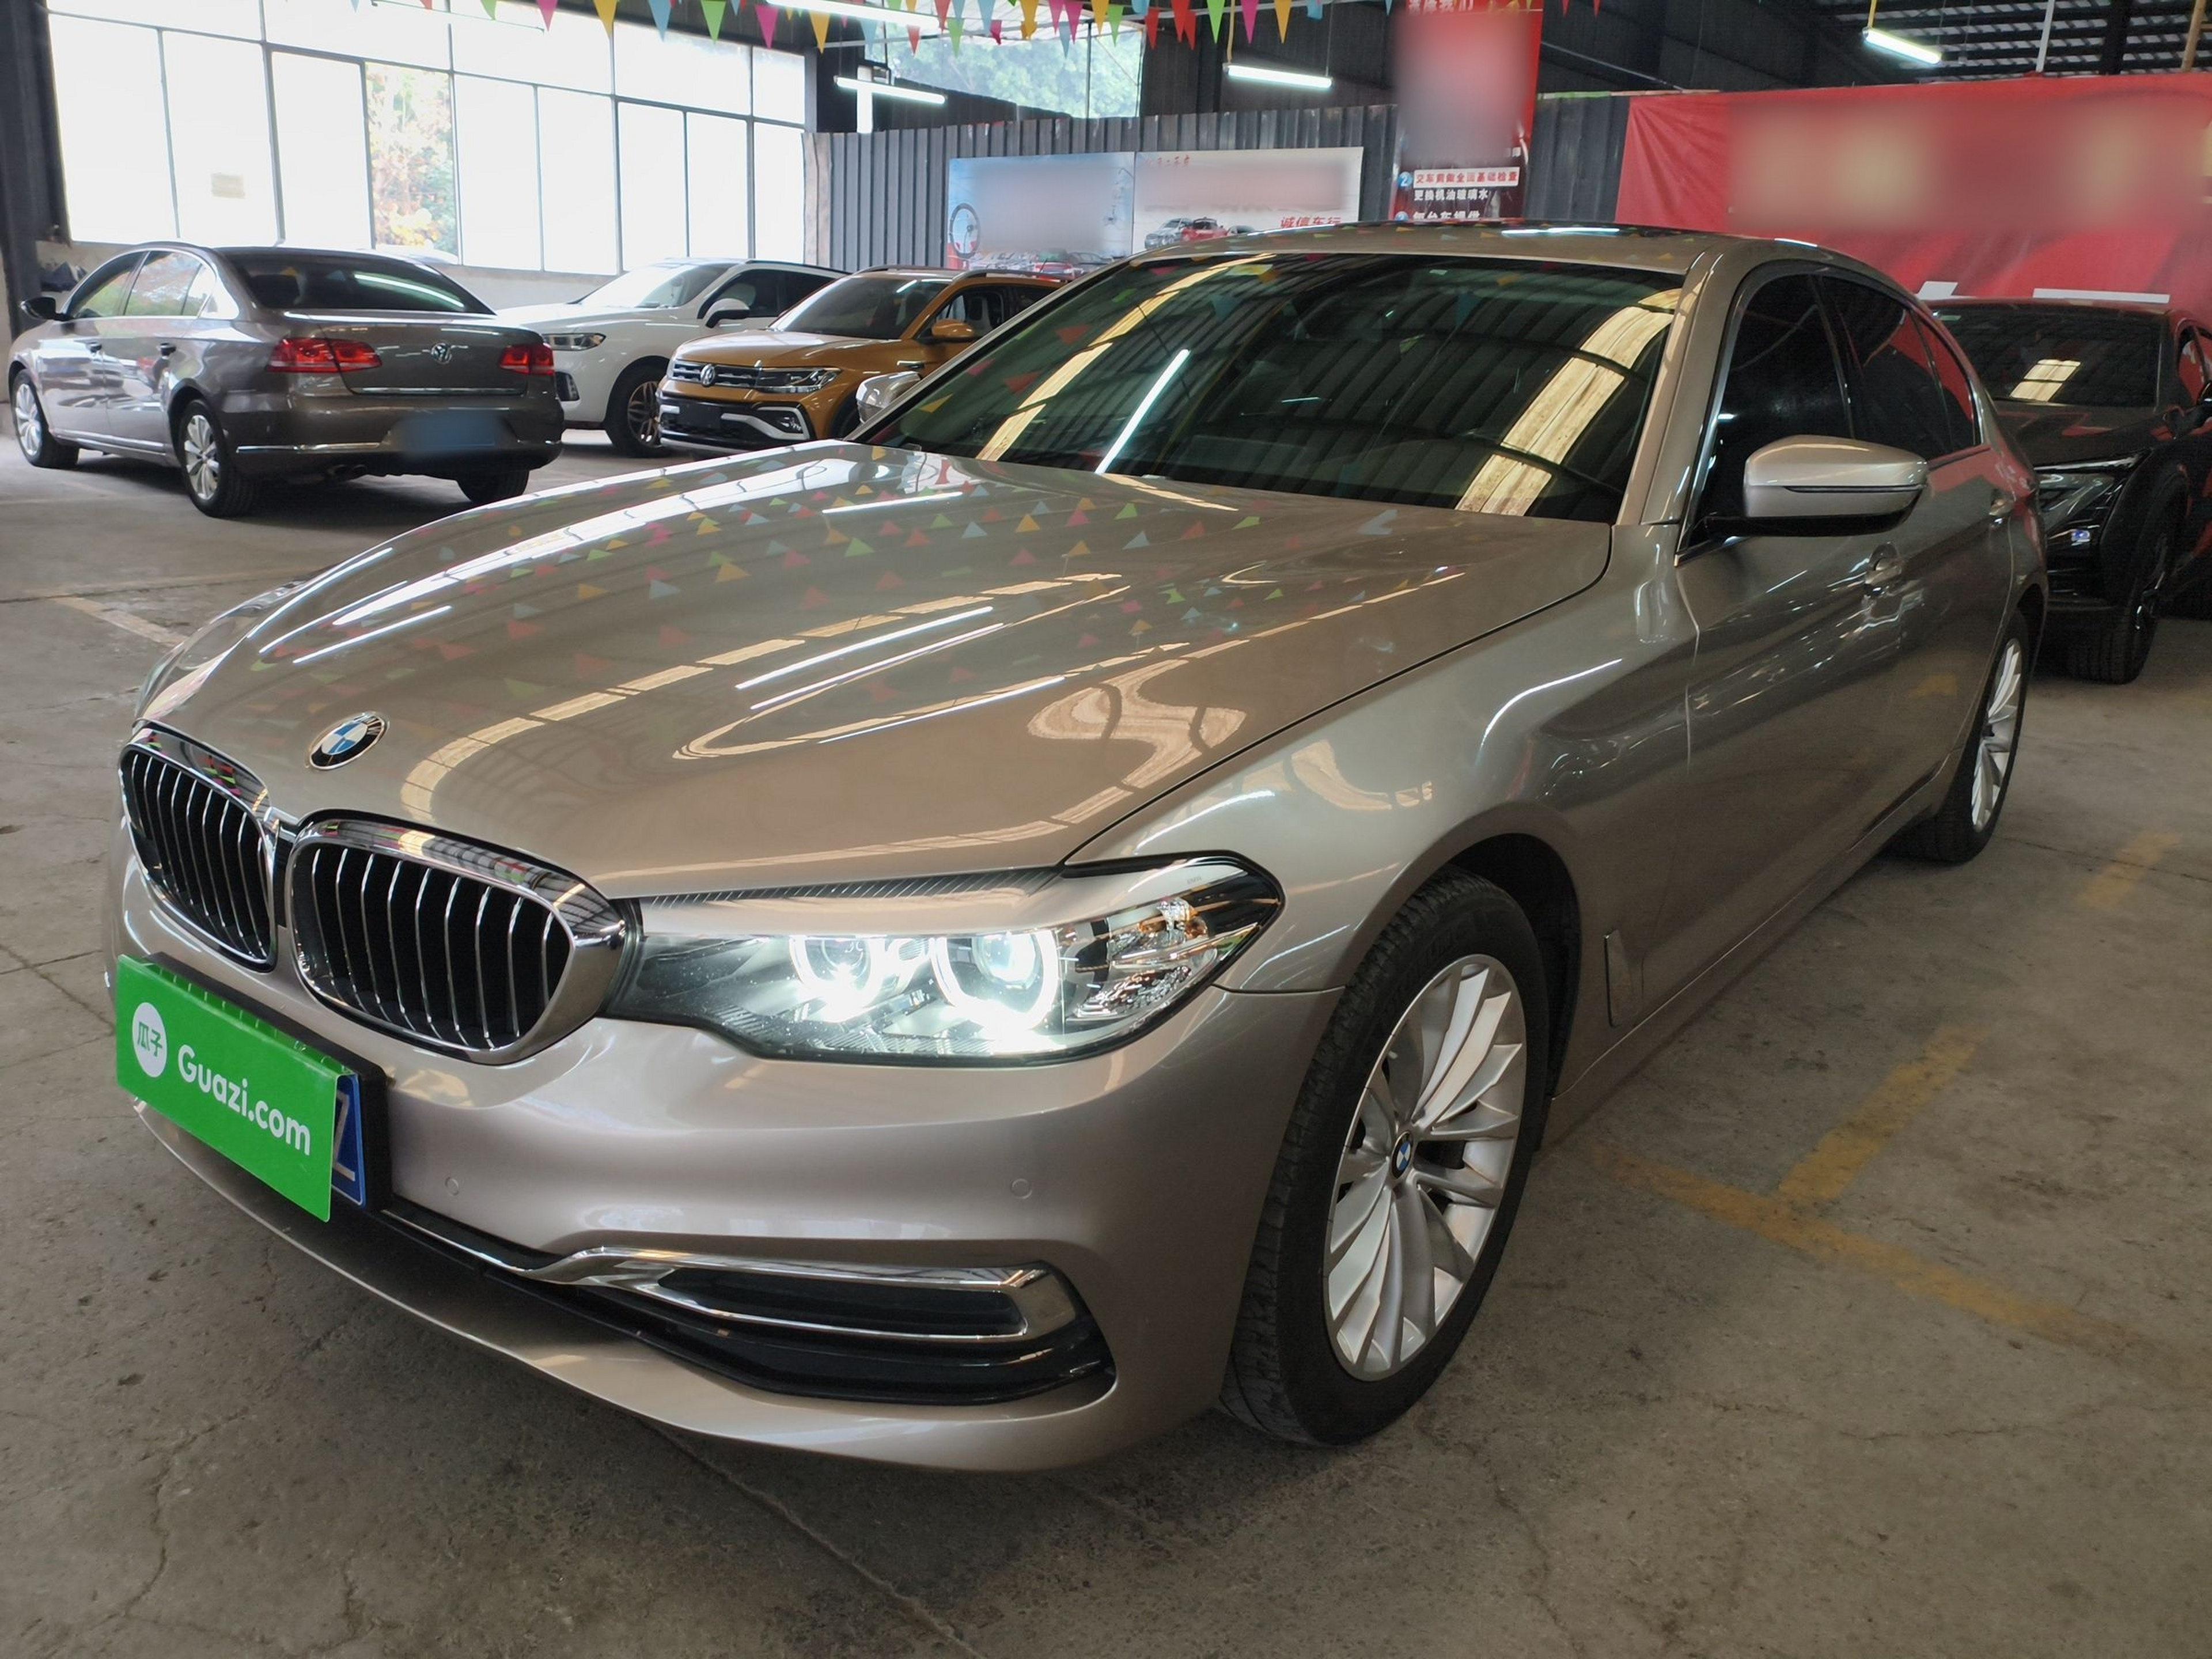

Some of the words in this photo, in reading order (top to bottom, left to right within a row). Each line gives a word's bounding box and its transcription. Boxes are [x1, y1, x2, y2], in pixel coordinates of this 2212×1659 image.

[1400, 175, 1409, 187] 2
[1414, 188, 1488, 201] 更换机油玻璃水
[137, 1021, 163, 1058] 瓜子
[178, 1044, 310, 1156] Guazi.com
